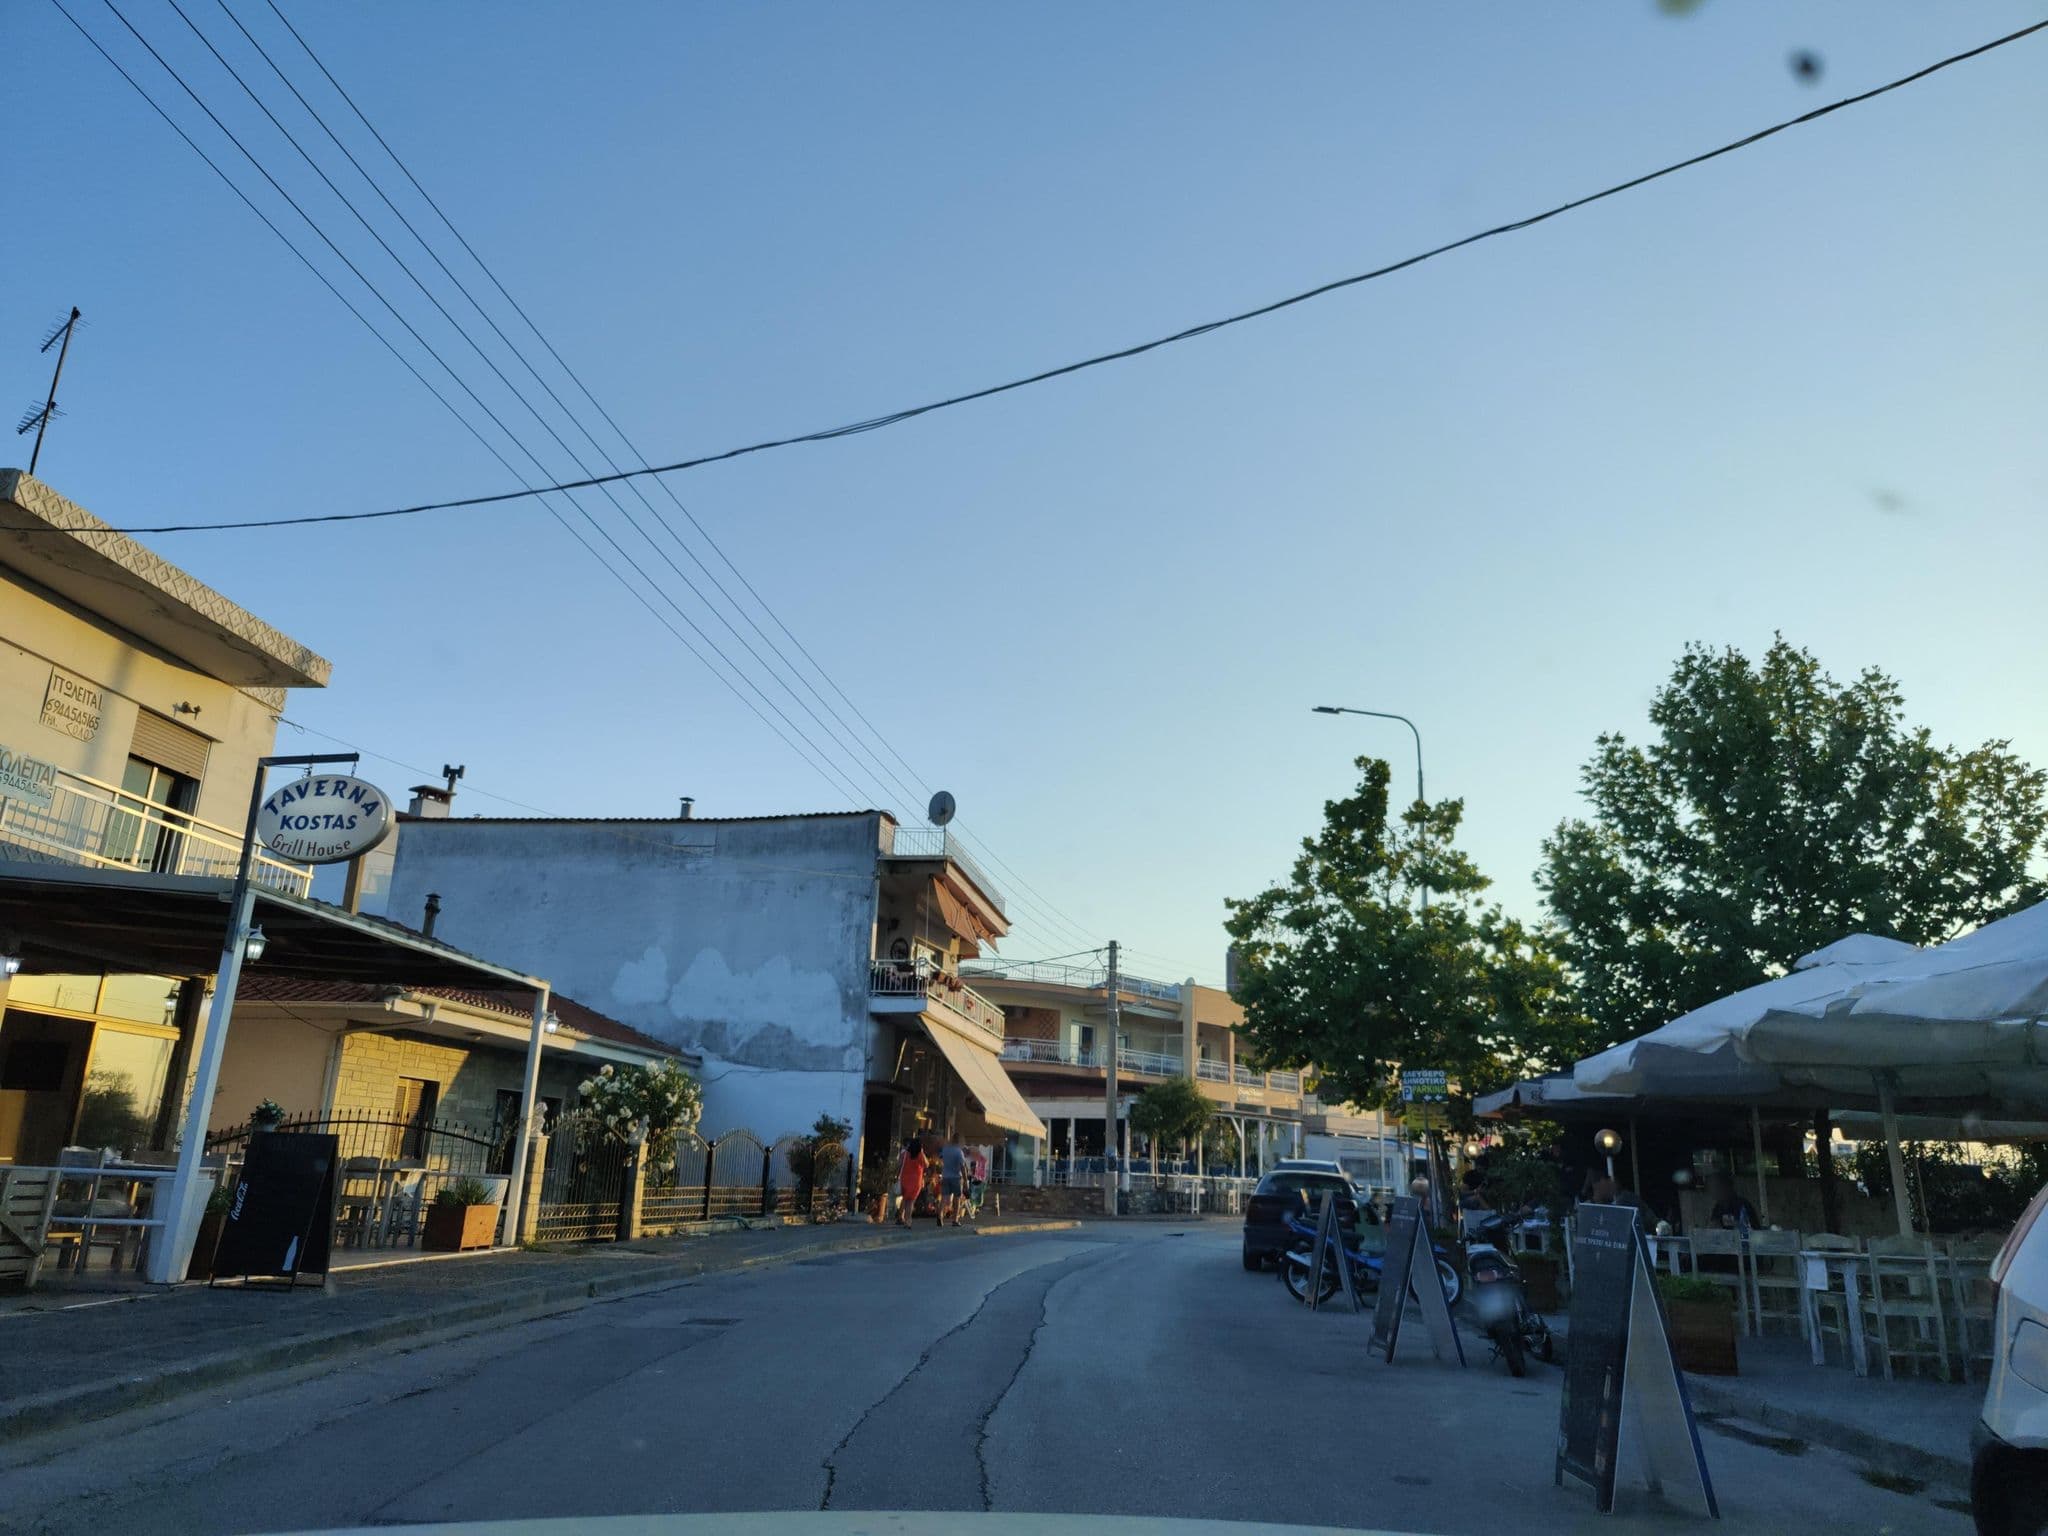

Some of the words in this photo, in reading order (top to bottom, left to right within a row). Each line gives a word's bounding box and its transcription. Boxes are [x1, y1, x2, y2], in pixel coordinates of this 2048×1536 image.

[264, 779, 380, 817] TAVERNA
[279, 814, 358, 830] KOSTAS
[271, 833, 304, 856] Grill
[306, 840, 351, 857] House
[1413, 1084, 1447, 1094] PARKING
